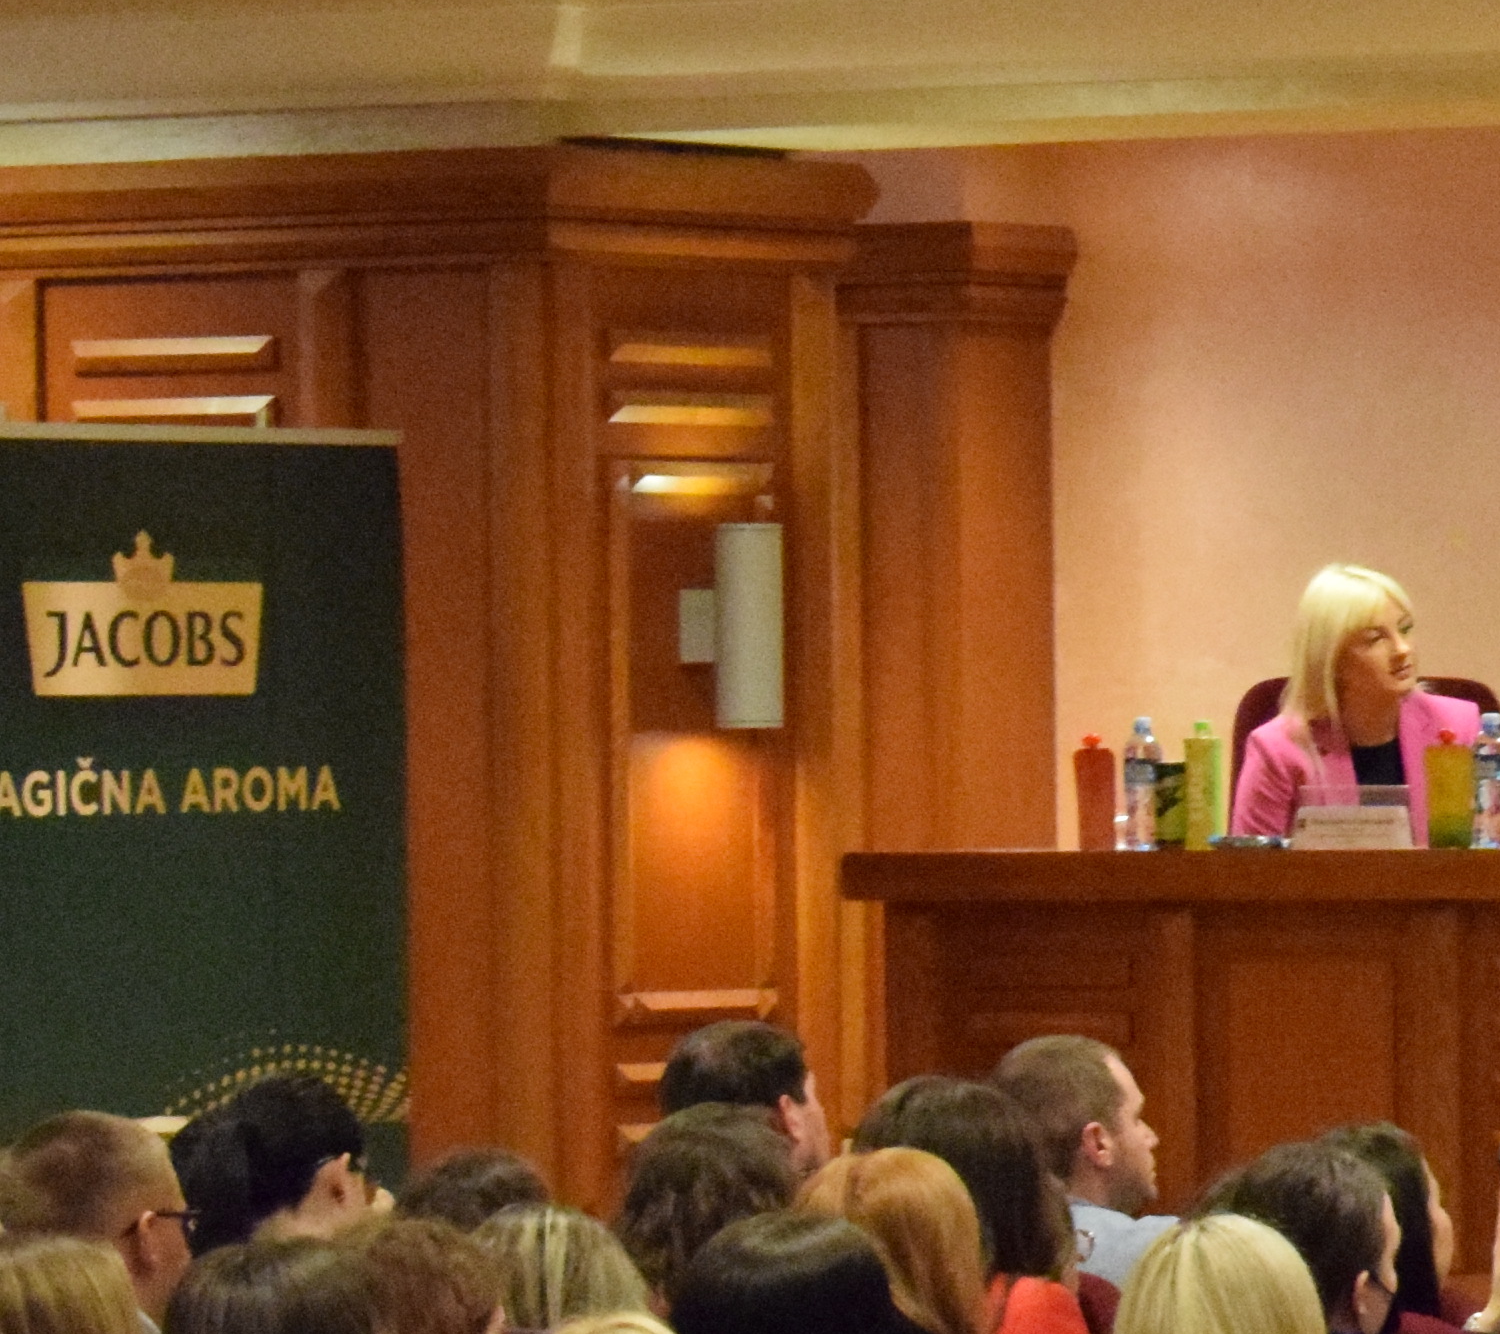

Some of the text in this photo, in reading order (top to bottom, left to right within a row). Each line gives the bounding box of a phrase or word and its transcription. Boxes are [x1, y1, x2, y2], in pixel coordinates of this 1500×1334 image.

[43, 610, 245, 678] JACOBS
[0, 756, 341, 817] AGIČNA AROMA
